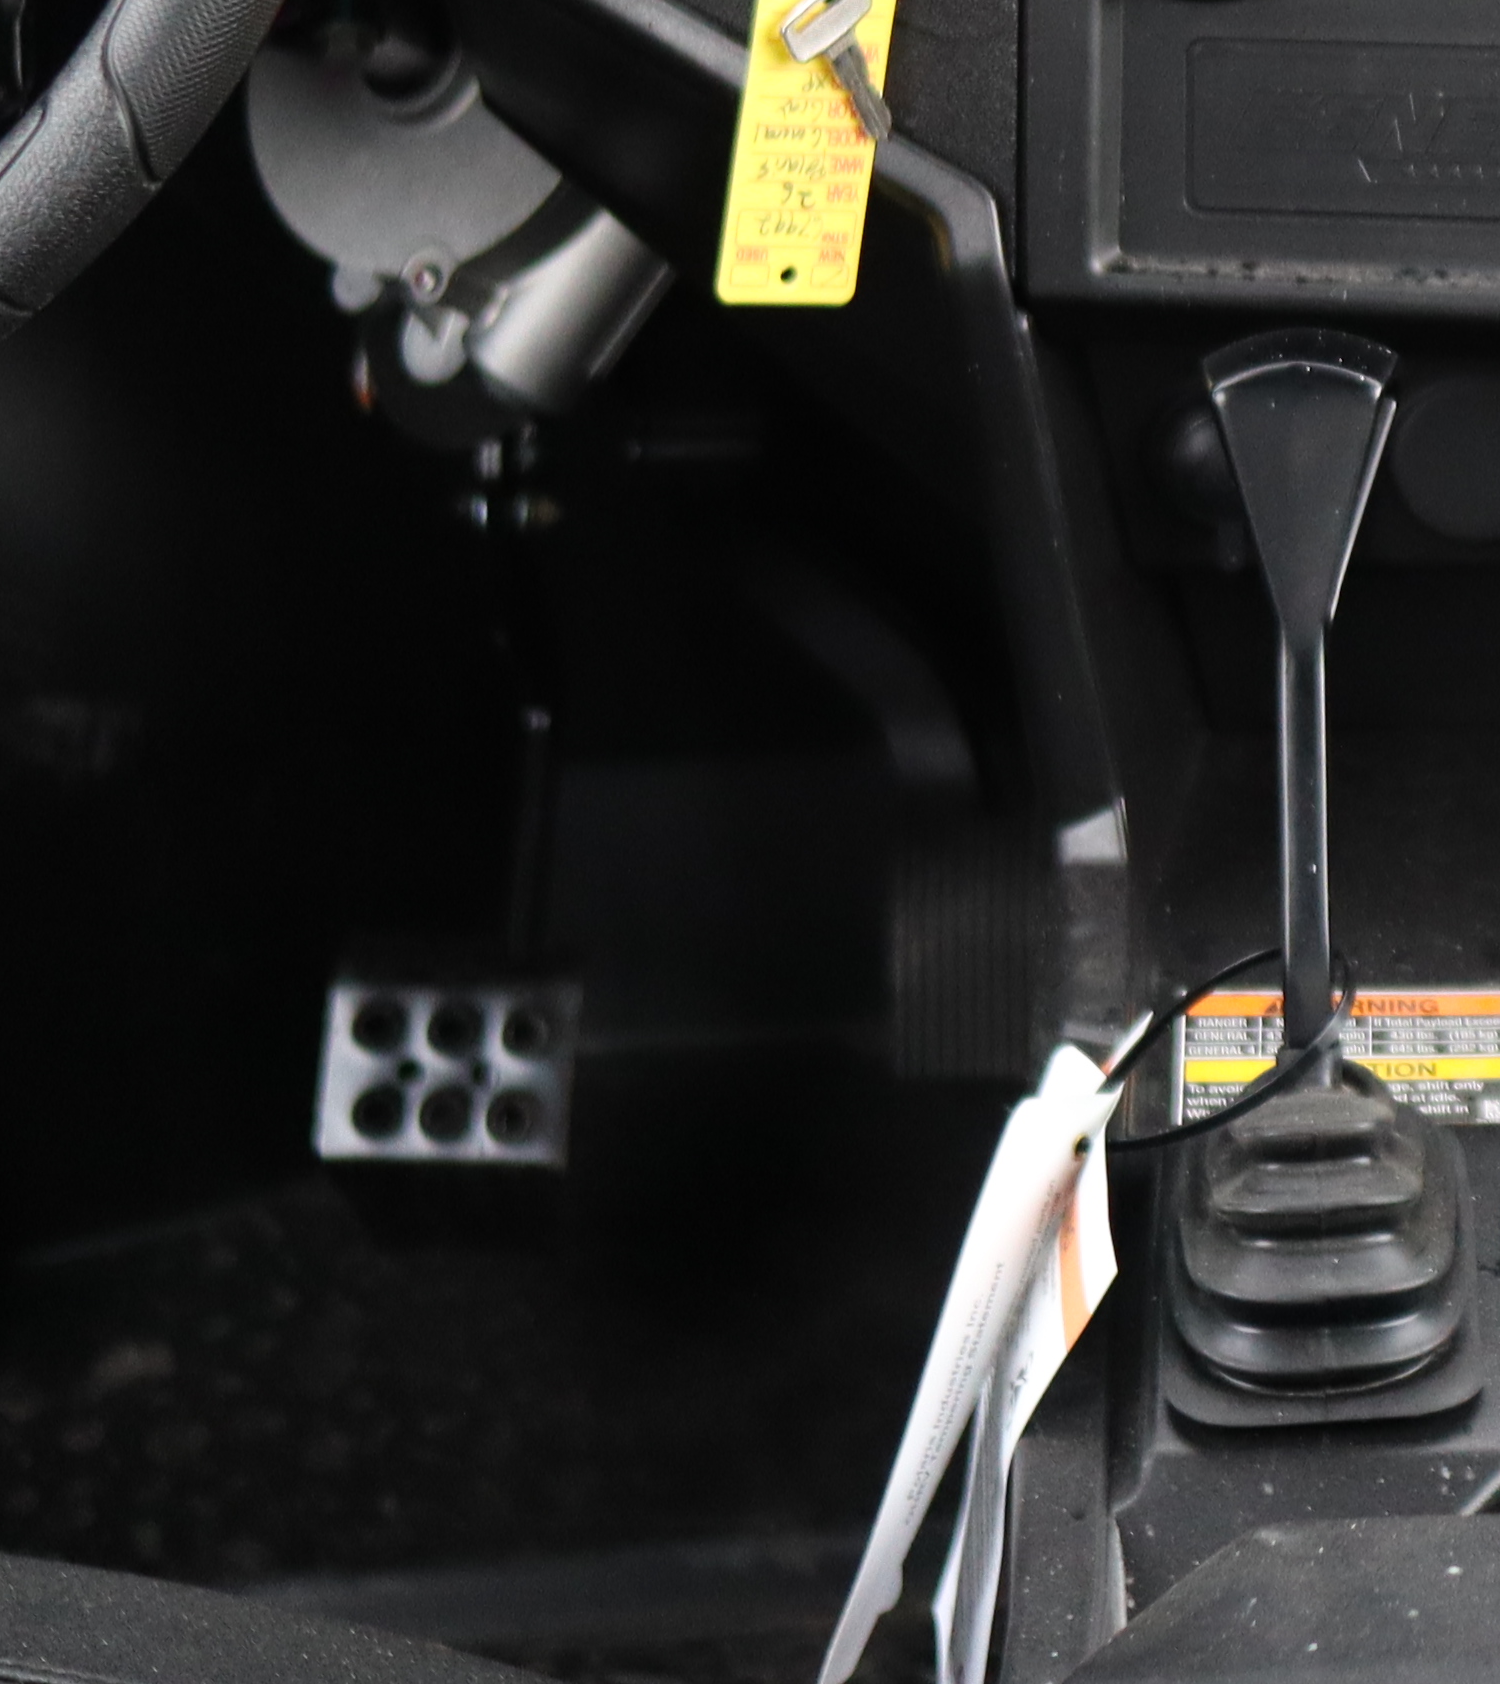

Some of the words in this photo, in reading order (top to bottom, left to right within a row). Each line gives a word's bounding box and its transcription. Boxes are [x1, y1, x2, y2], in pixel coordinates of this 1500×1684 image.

[828, 128, 868, 147] MODEL
[830, 155, 864, 175] MAKE
[782, 181, 815, 209] 26
[827, 183, 859, 203] YEAR
[736, 248, 768, 261] USED
[1416, 1017, 1463, 1029] Payload
[1189, 1083, 1205, 1093] To
[1453, 1081, 1484, 1092] only
[1186, 1096, 1227, 1107] when
[1412, 1093, 1426, 1103] at
[1455, 1104, 1469, 1114] in
[931, 1364, 973, 1463] Tampering
[970, 1261, 1004, 1363] Statement
[934, 1333, 971, 1430] Industries
